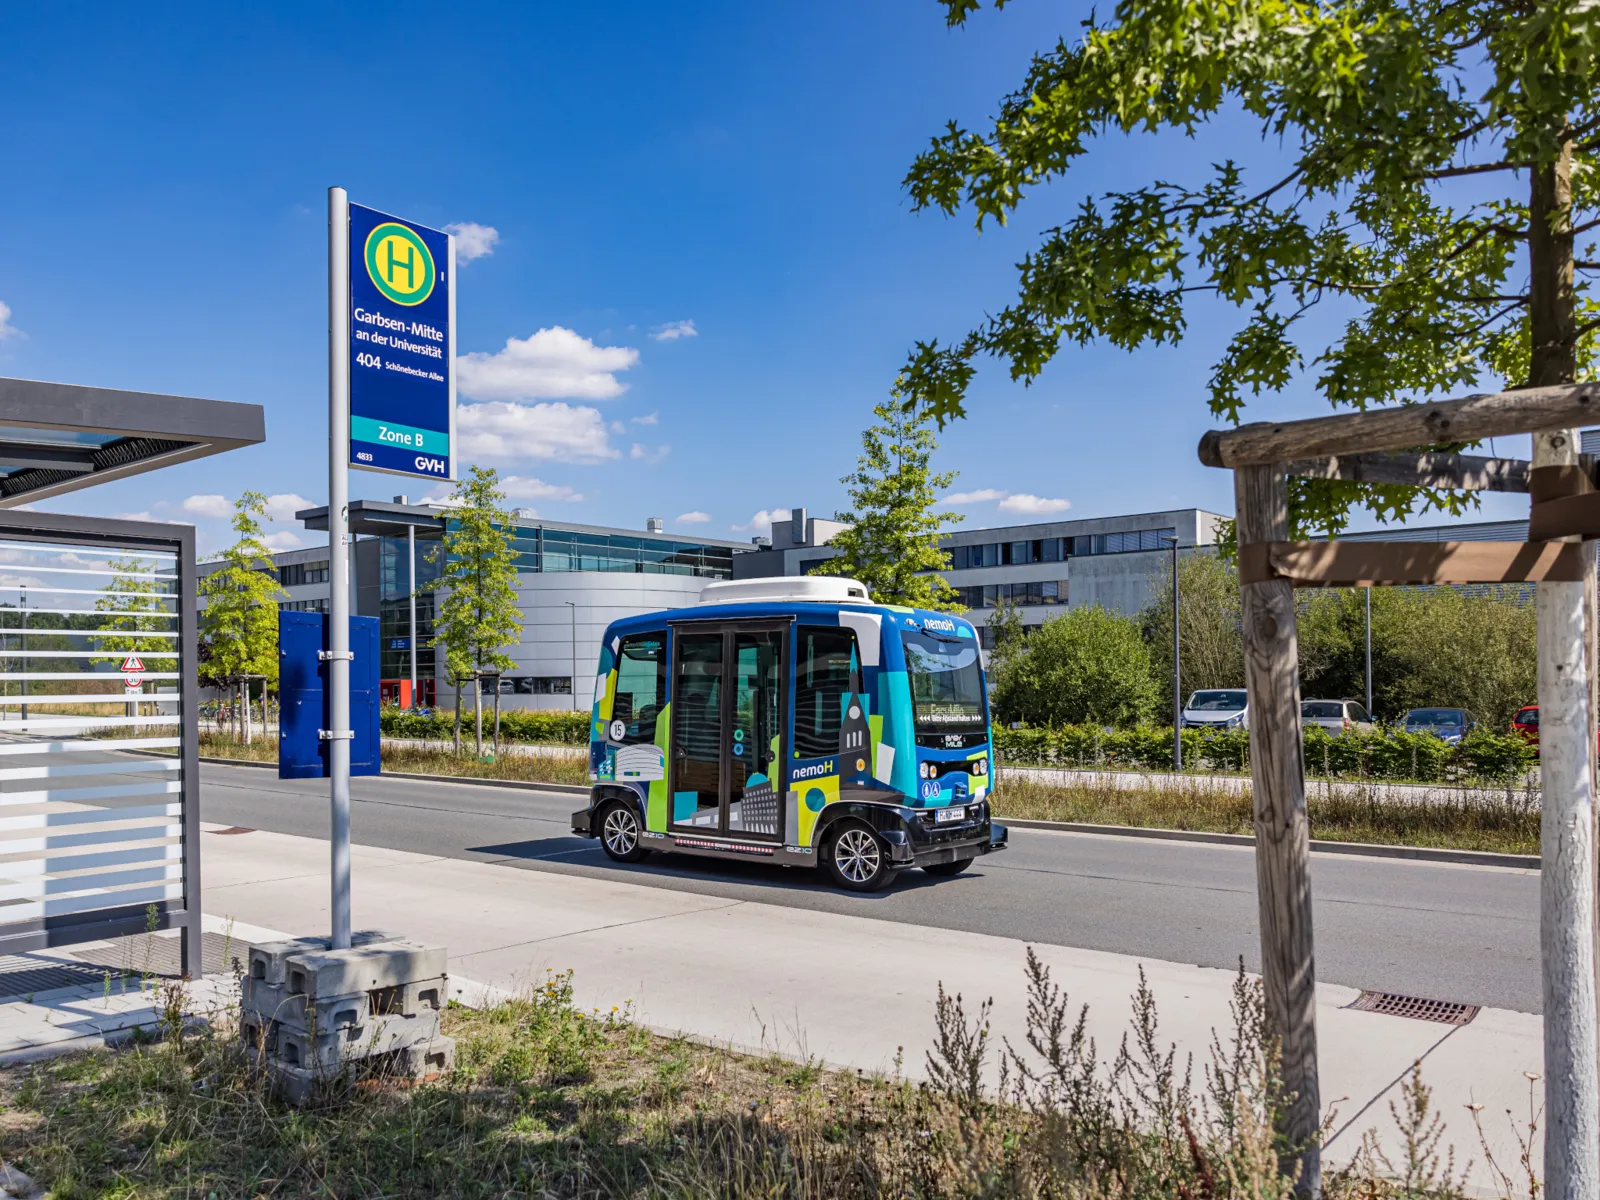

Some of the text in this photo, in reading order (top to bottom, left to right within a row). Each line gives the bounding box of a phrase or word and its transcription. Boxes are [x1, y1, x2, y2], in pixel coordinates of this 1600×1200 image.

[387, 240, 414, 289] H
[354, 307, 443, 342] Garbsen-Mitte
[356, 330, 442, 359] an der Universität
[356, 352, 444, 382] 404 Schönebecker Allee
[378, 426, 424, 447] Zone B
[356, 452, 445, 474] 4833 GVH
[923, 618, 956, 632] nemoH
[614, 724, 622, 737] 15
[792, 760, 833, 779] nemoH
